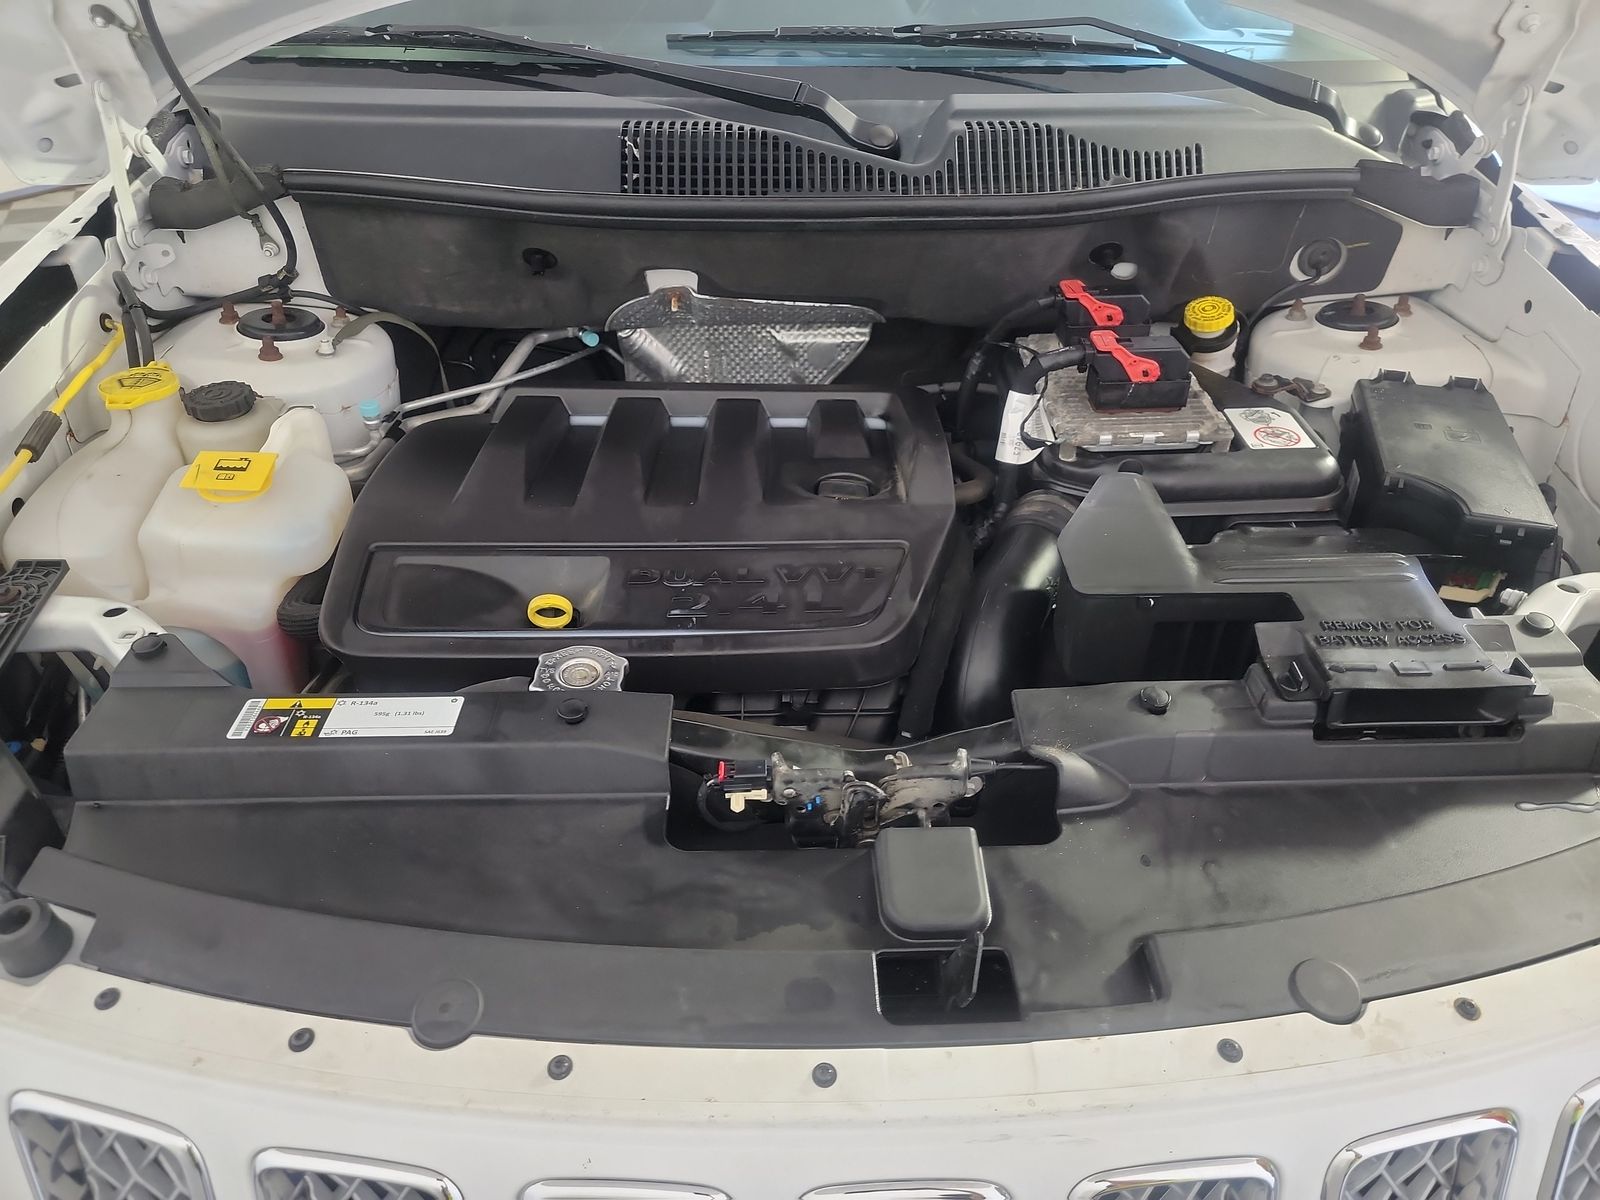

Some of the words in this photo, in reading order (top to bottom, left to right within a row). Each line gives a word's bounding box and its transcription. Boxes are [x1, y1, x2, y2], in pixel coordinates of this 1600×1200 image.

[627, 567, 766, 587] DUAL
[775, 565, 885, 584] VVT
[1319, 618, 1394, 632] REMOVE
[1396, 618, 1435, 632] FOR
[1315, 633, 1390, 647] BATTERY
[1398, 632, 1467, 647] ACCESS
